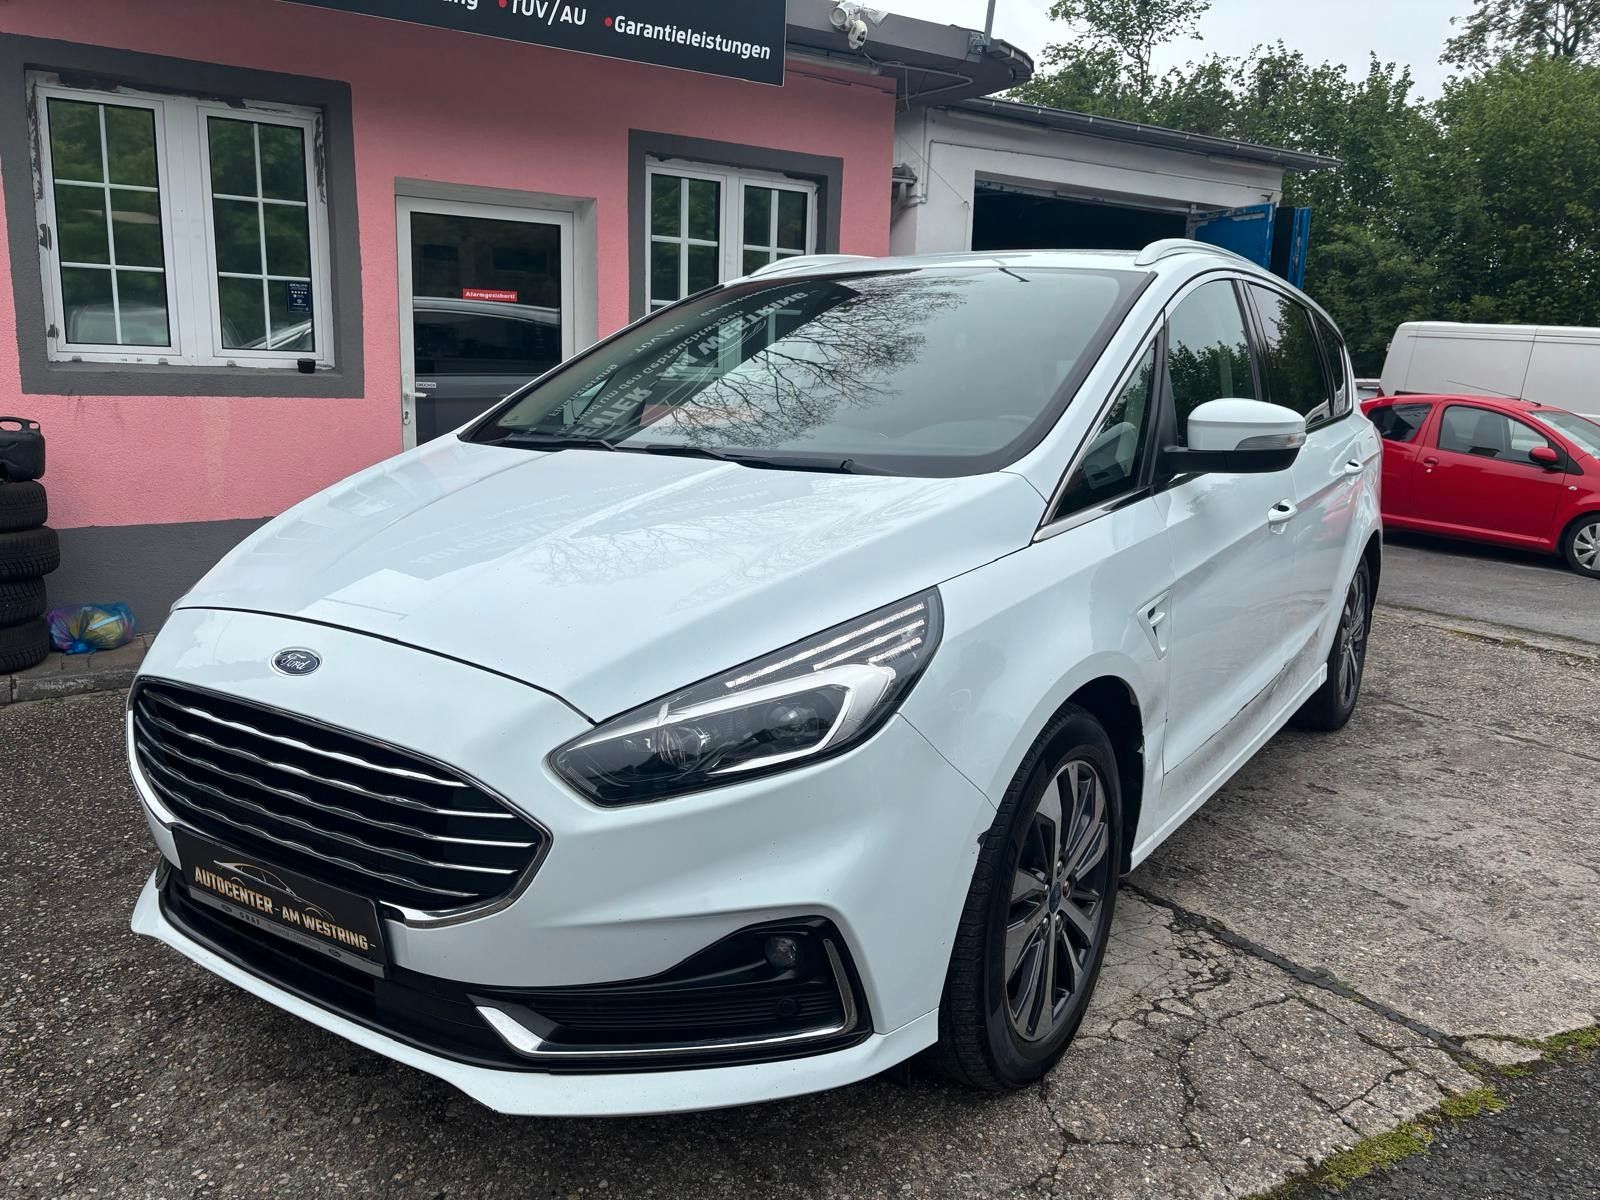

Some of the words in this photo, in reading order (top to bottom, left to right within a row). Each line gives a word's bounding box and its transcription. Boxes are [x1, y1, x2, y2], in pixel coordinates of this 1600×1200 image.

[615, 15, 771, 60] Garantieleistungen
[280, 653, 311, 670] Ford
[194, 866, 273, 914] AUTOCENTER
[282, 905, 300, 926] AM
[302, 914, 369, 950] WESTRING
